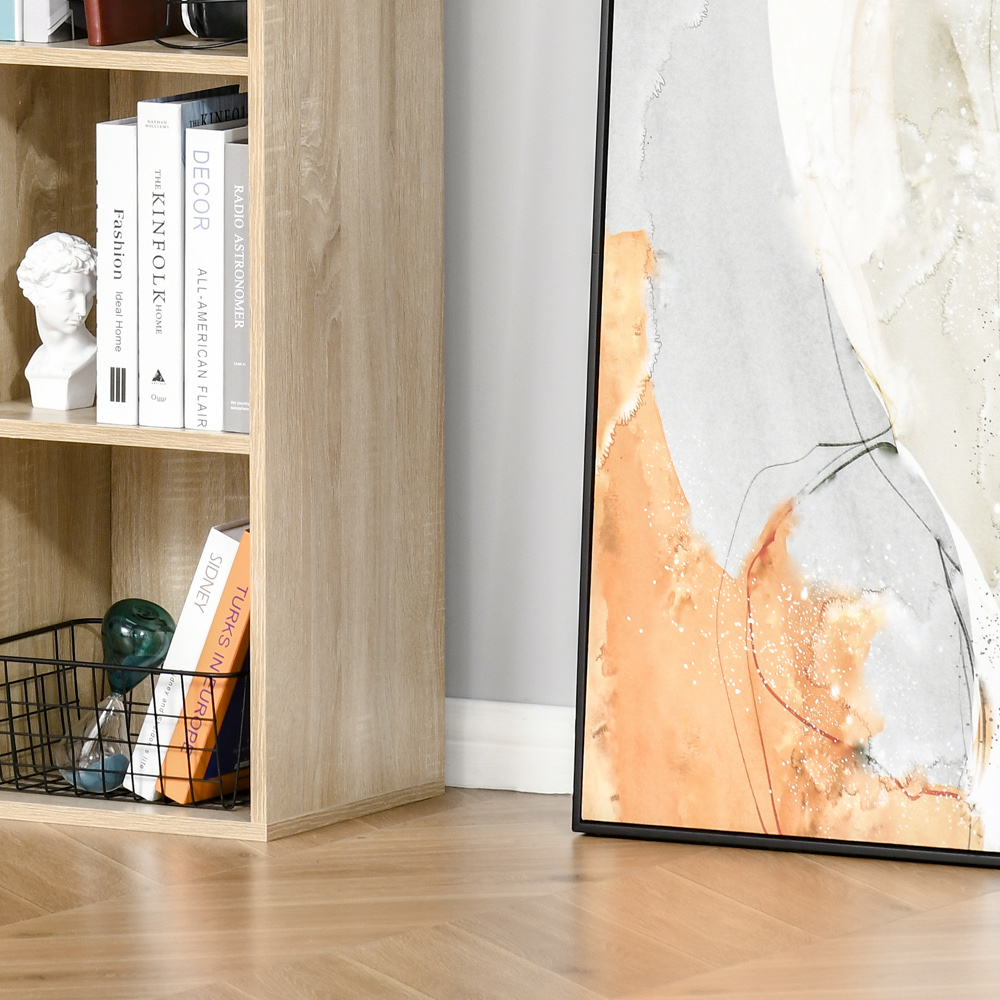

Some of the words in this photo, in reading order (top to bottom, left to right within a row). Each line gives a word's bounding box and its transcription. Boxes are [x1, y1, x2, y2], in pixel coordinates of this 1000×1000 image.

[154, 169, 162, 190] THE
[193, 150, 210, 231] DECOR
[233, 184, 244, 229] RADIO
[113, 207, 125, 280] Fashion
[151, 191, 166, 304] KINFOLK
[115, 291, 124, 319] Ideal
[233, 233, 245, 329] ASTRONOMER
[155, 304, 163, 335] HOME
[197, 267, 208, 379] ALL-AMERICAN
[197, 385, 208, 427] FLAIR
[194, 552, 223, 614] SIDNEY
[217, 585, 249, 649] TURKS
[209, 651, 225, 673] IN
[181, 676, 217, 757] EUROPE
